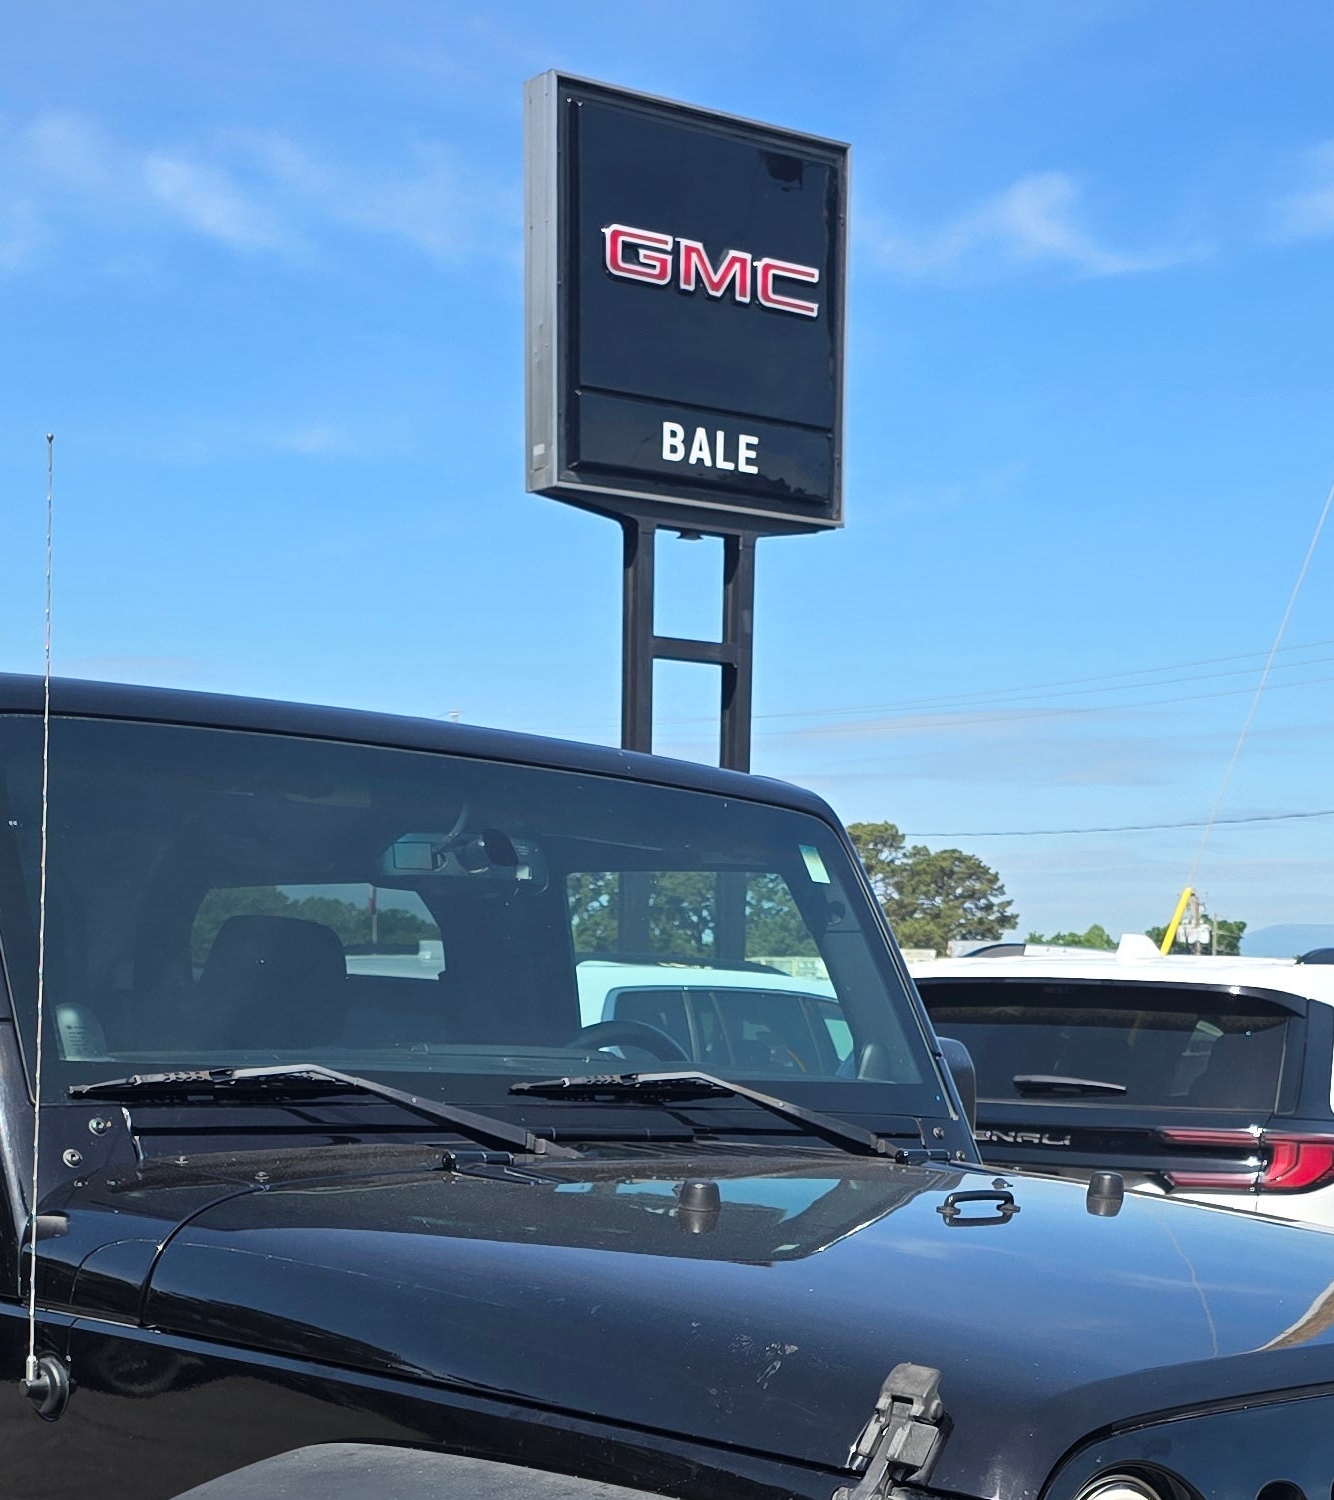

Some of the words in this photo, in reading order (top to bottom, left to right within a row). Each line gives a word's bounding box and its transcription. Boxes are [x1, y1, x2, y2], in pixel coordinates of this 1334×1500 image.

[601, 223, 820, 318] GMC
[662, 422, 759, 474] BALE
[974, 1130, 1071, 1146] ENALI
